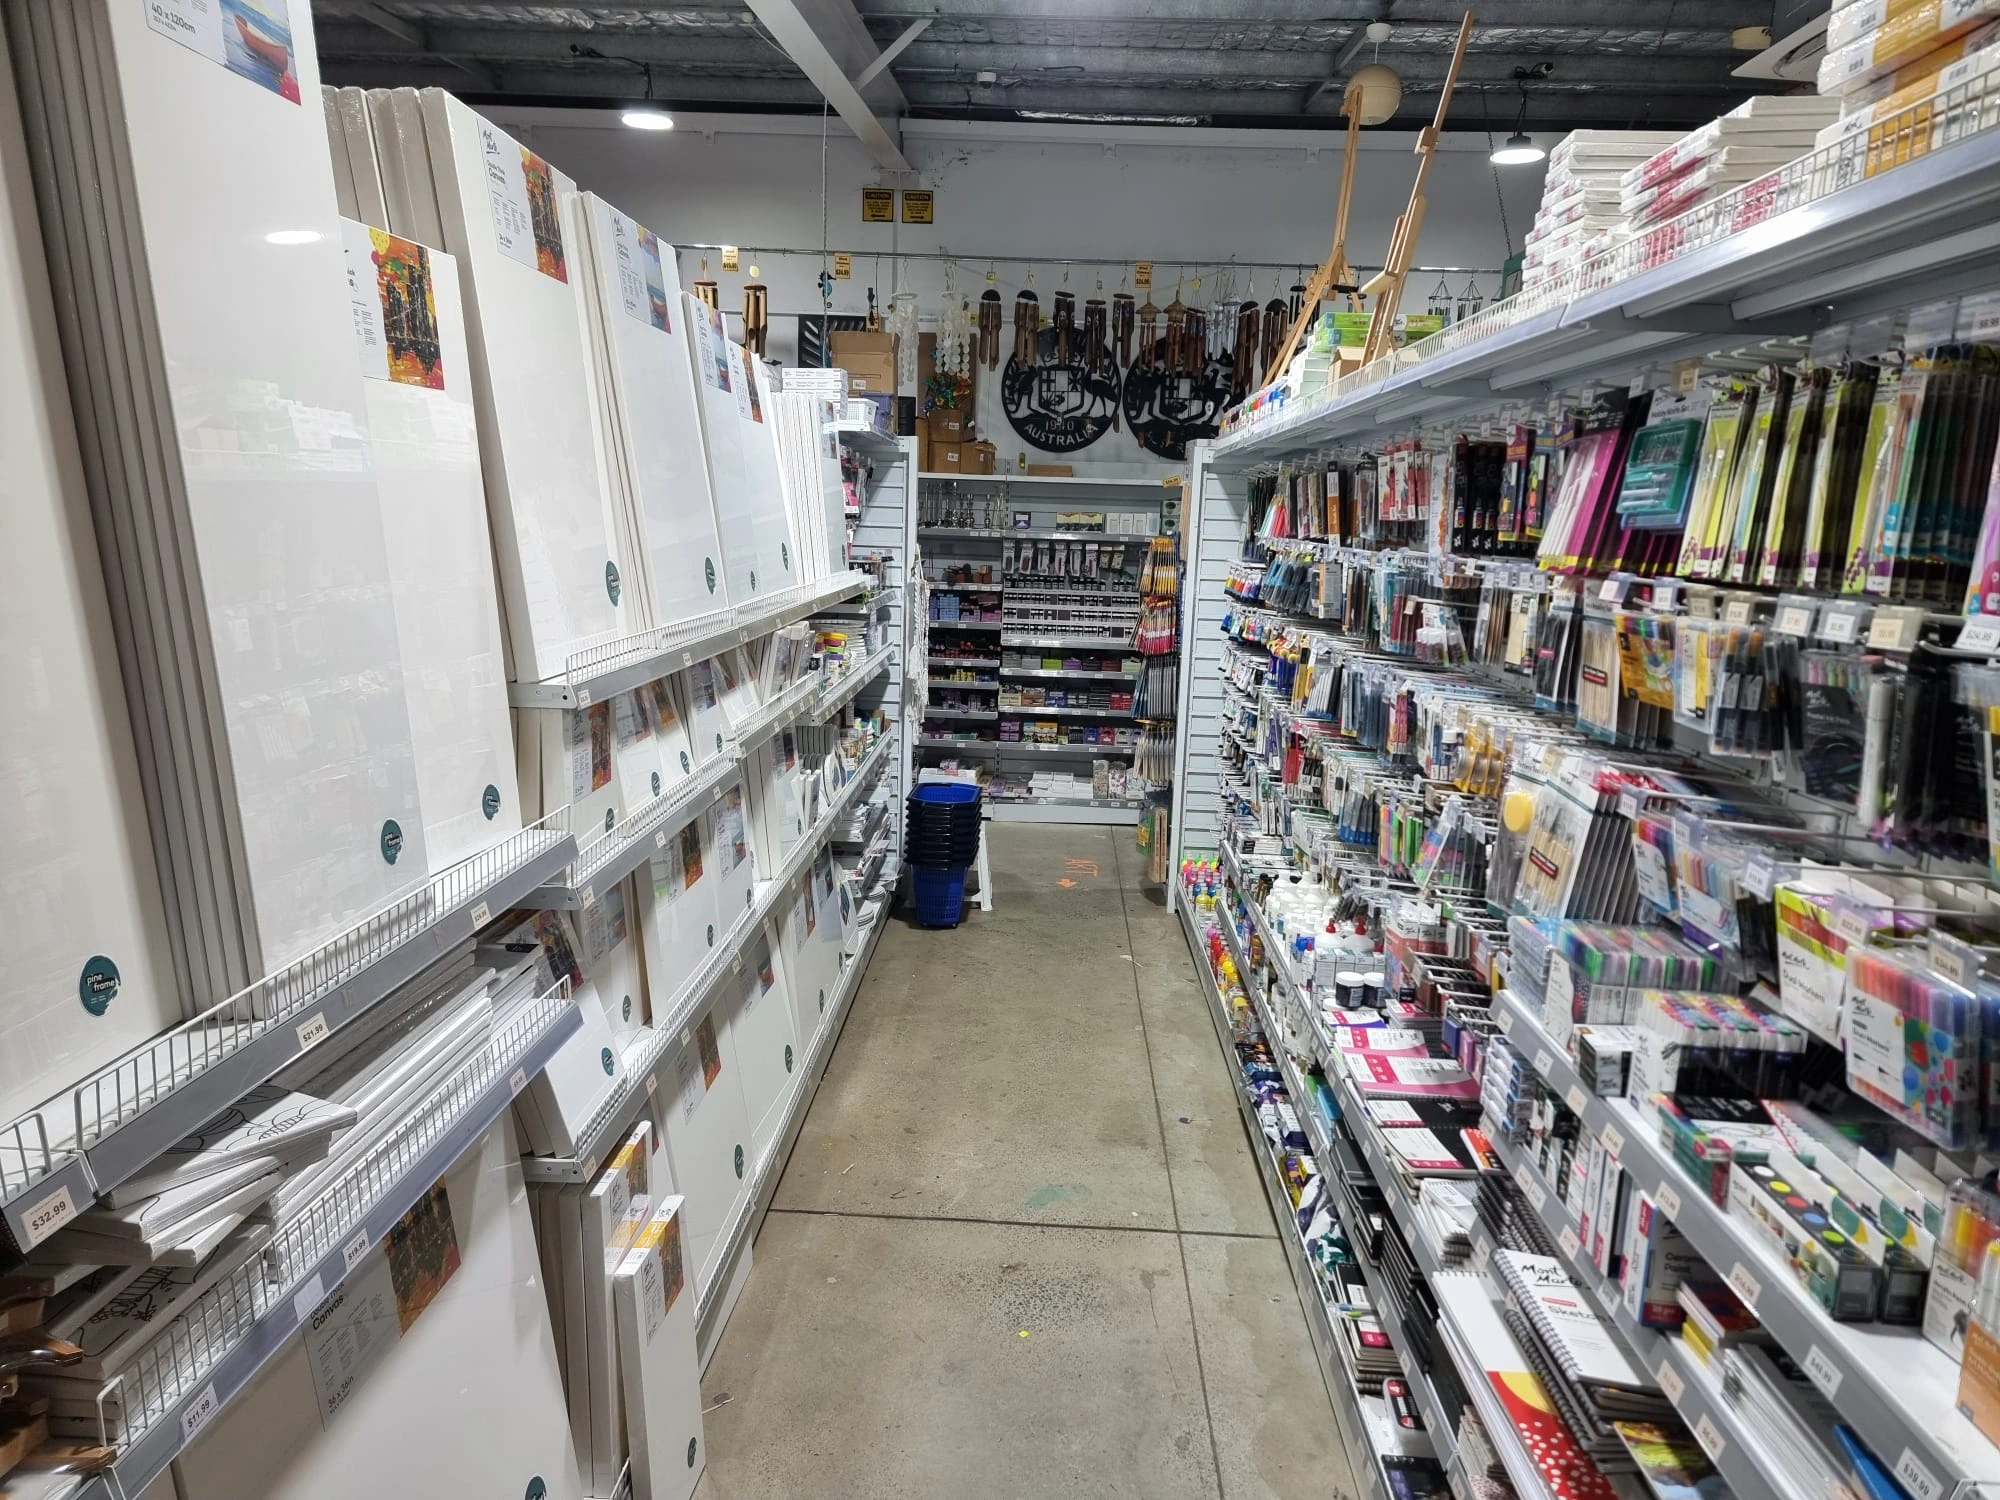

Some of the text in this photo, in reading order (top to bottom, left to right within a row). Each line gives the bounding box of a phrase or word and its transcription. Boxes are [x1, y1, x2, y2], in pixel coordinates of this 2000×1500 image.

[151, 3, 163, 17] 40
[171, 12, 196, 34] 120cm
[1024, 423, 1099, 446] AUSTRALIA
[87, 974, 103, 987] pine
[94, 979, 115, 992] frame
[303, 1023, 323, 1042] $21.99
[31, 1201, 66, 1231] $32.99
[348, 1239, 366, 1261] $19.99
[1521, 1264, 1562, 1277] Mont
[312, 1294, 344, 1331] Canvas
[187, 1399, 210, 1428] $11.99
